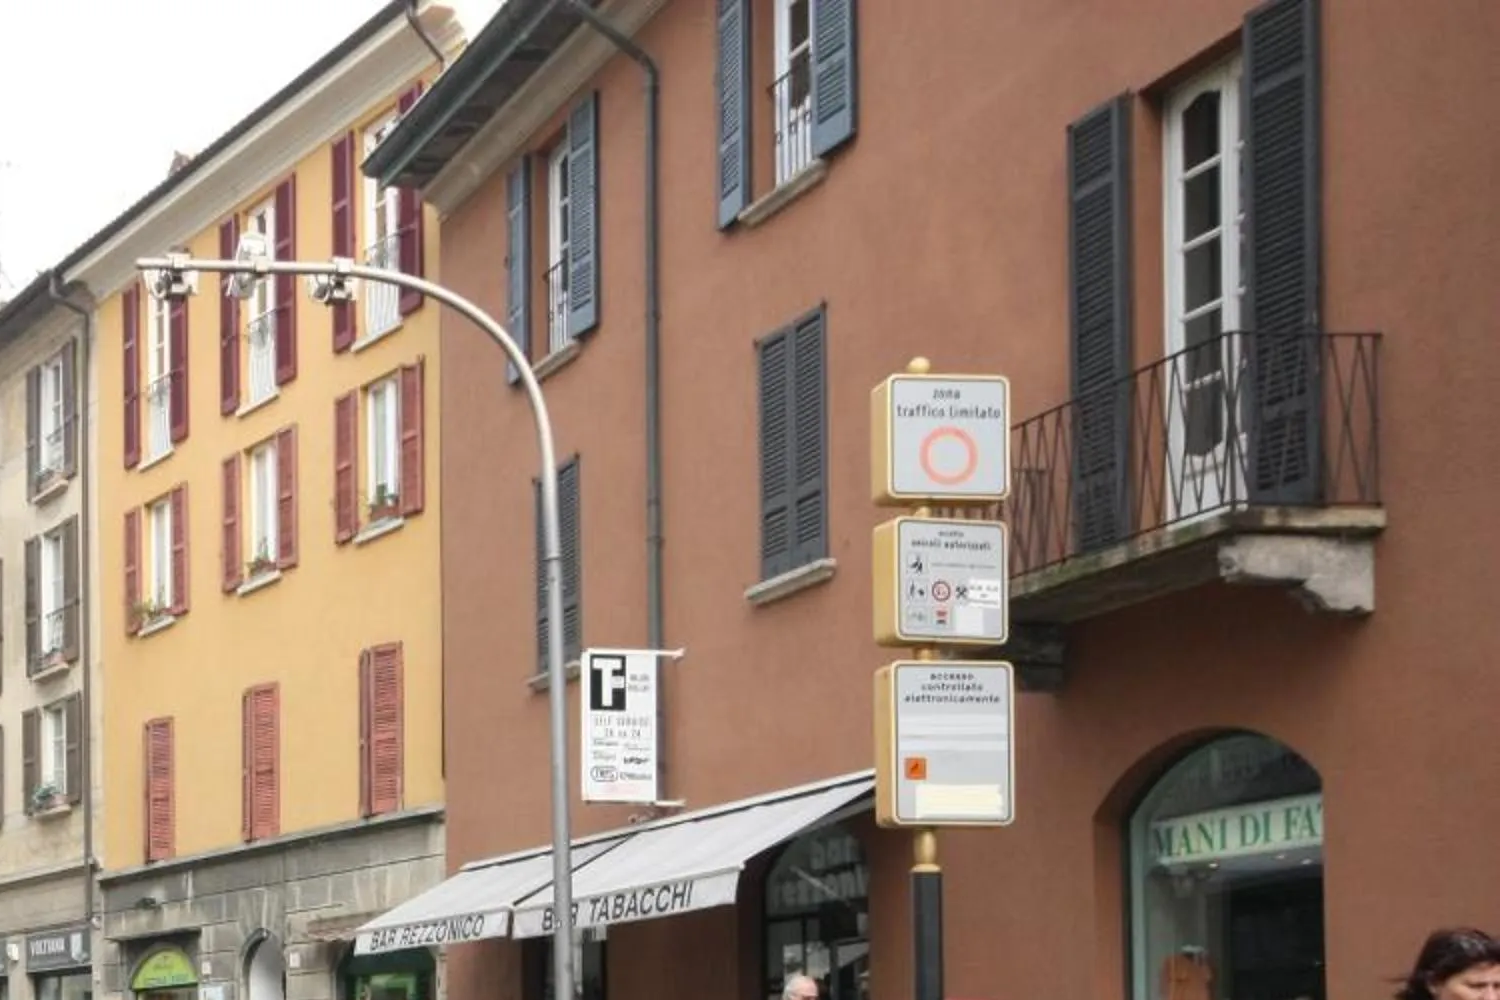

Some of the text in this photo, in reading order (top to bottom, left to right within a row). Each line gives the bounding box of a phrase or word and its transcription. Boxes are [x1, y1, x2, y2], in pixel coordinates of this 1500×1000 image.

[896, 405, 1001, 419] traffico limitato
[930, 672, 975, 681] accesso
[920, 683, 984, 692] controllato
[904, 693, 1001, 704] elettronicamente
[1153, 801, 1323, 857] MANI DI FA
[589, 879, 694, 923] TABACCHI
[369, 914, 485, 951] BAR REZZONICO
